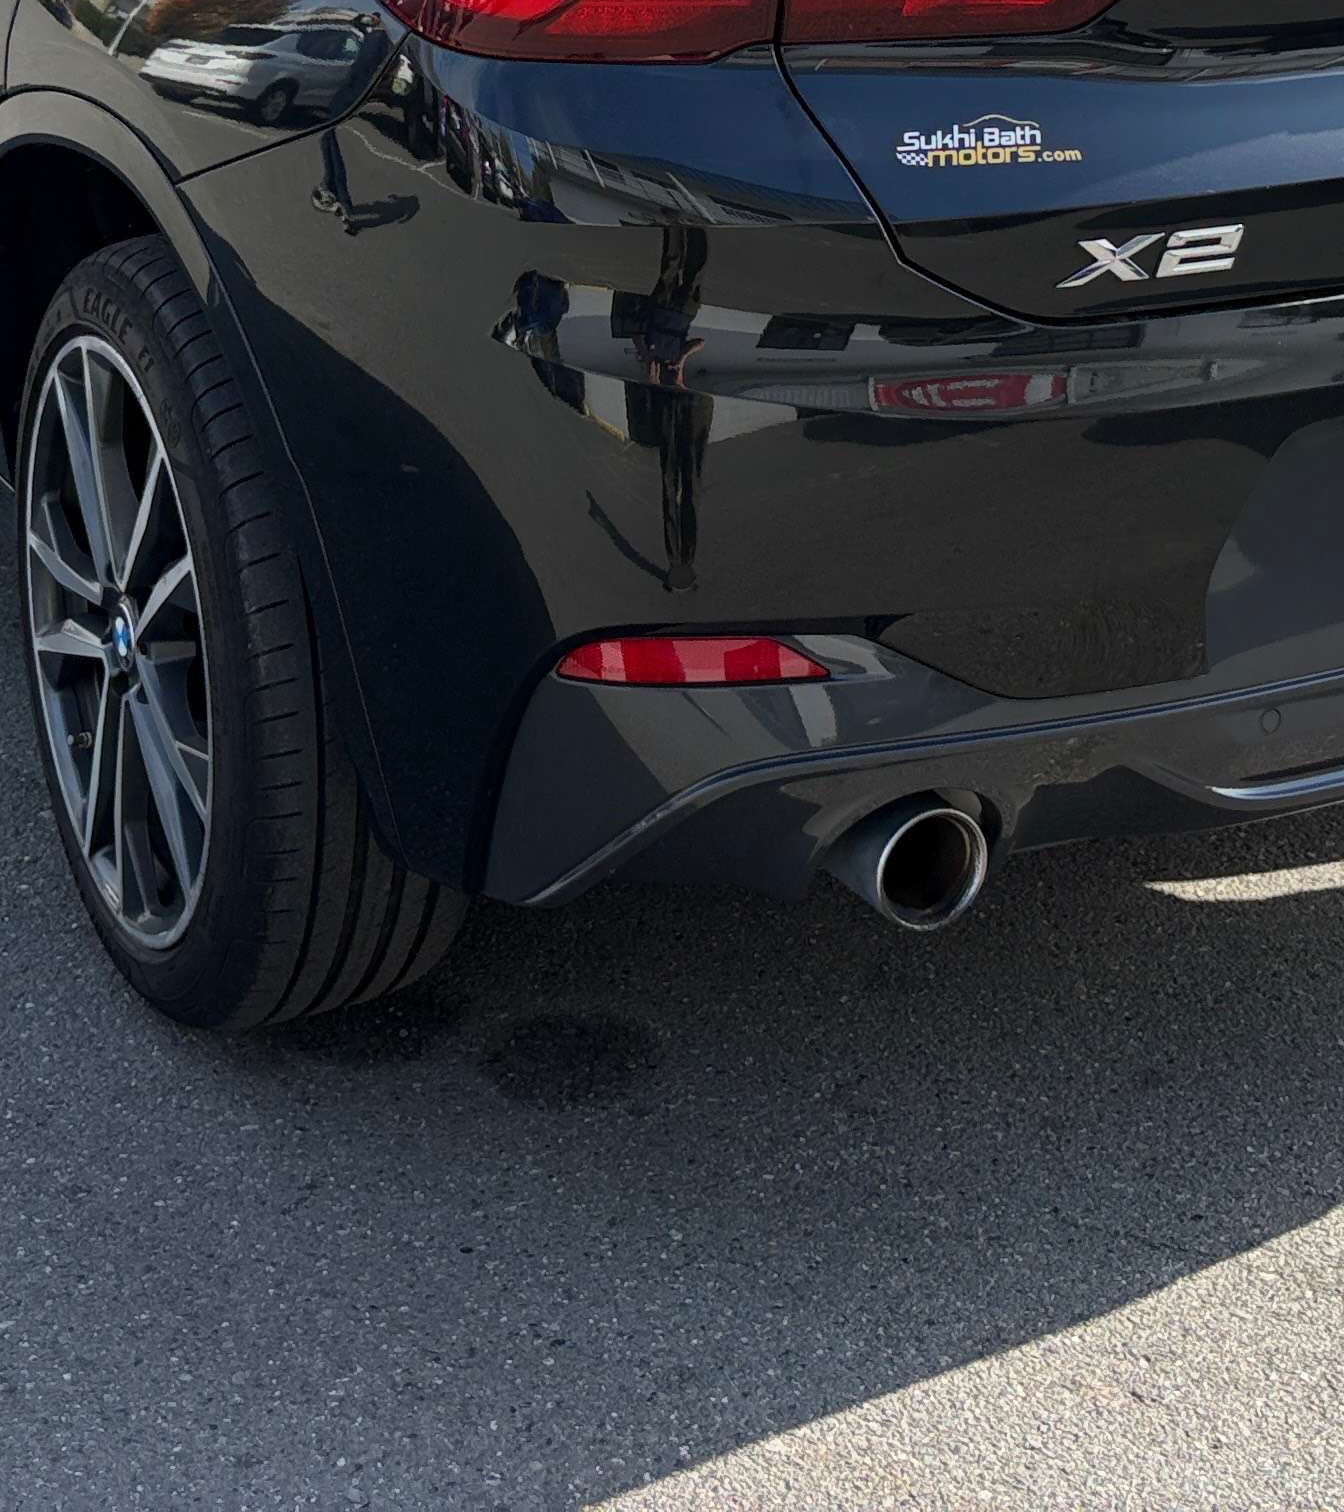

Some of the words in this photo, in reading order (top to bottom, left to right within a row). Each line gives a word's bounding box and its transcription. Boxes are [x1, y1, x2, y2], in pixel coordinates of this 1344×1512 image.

[896, 125, 976, 151] Sukhi
[983, 126, 1042, 148] Bath
[1055, 224, 1245, 288] X2
